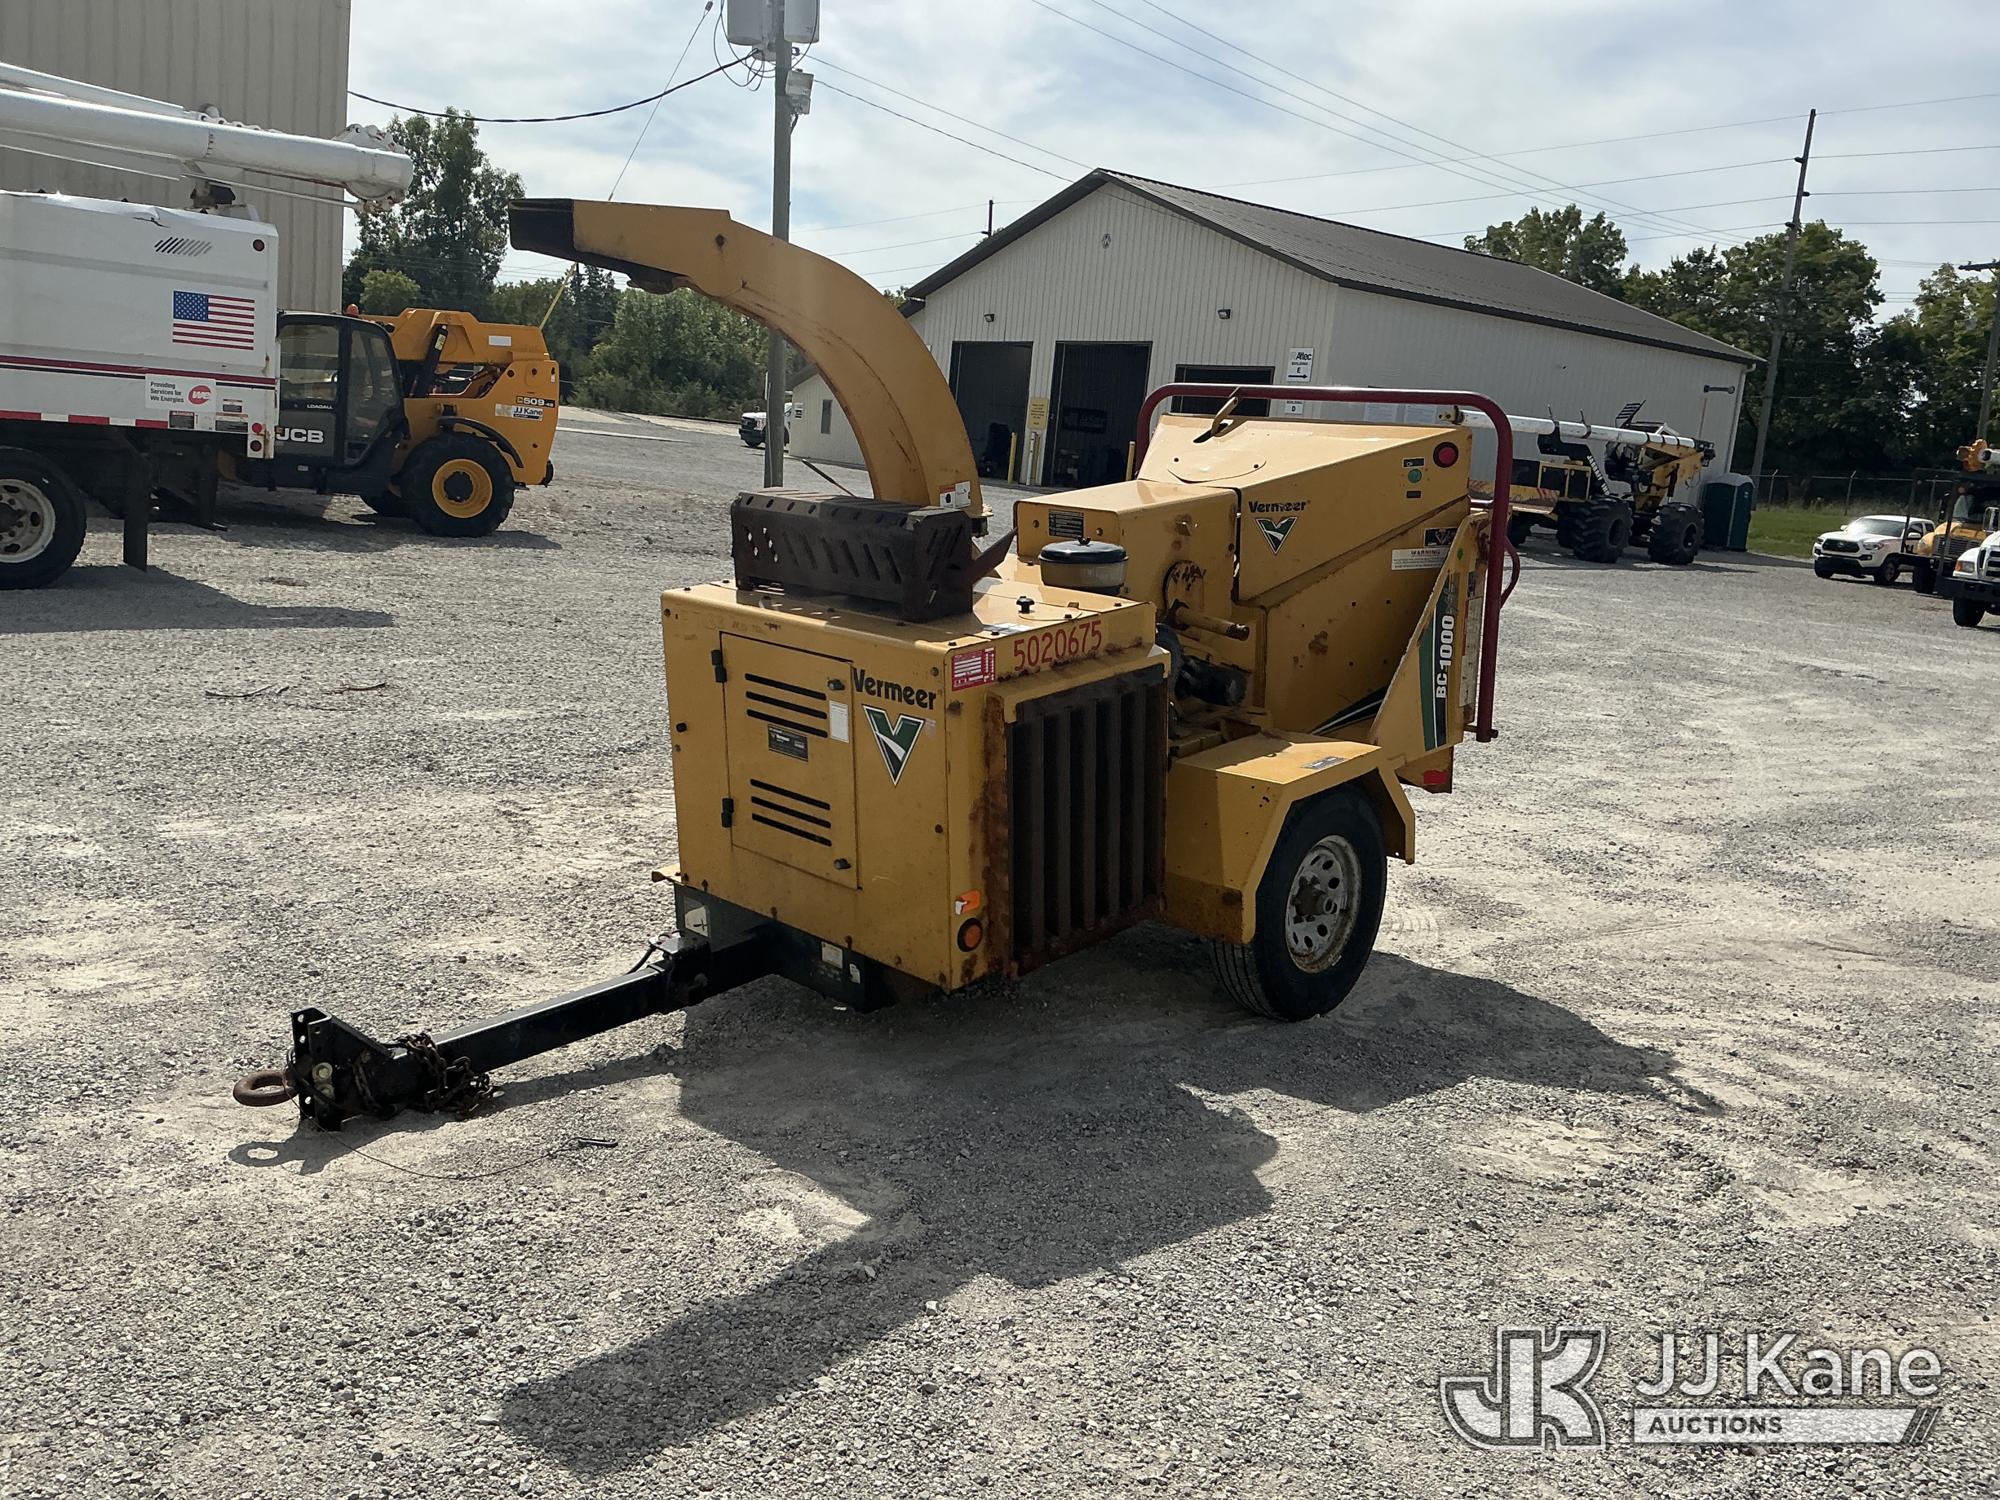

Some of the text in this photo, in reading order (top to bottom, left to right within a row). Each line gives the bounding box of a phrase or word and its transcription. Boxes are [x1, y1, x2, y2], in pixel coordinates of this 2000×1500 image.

[150, 381, 176, 390] Providing
[150, 388, 174, 396] Services
[275, 427, 324, 443] JCB
[1248, 500, 1307, 513] Vermeer
[1013, 620, 1102, 672] 5020675
[852, 666, 937, 710] Vermeer
